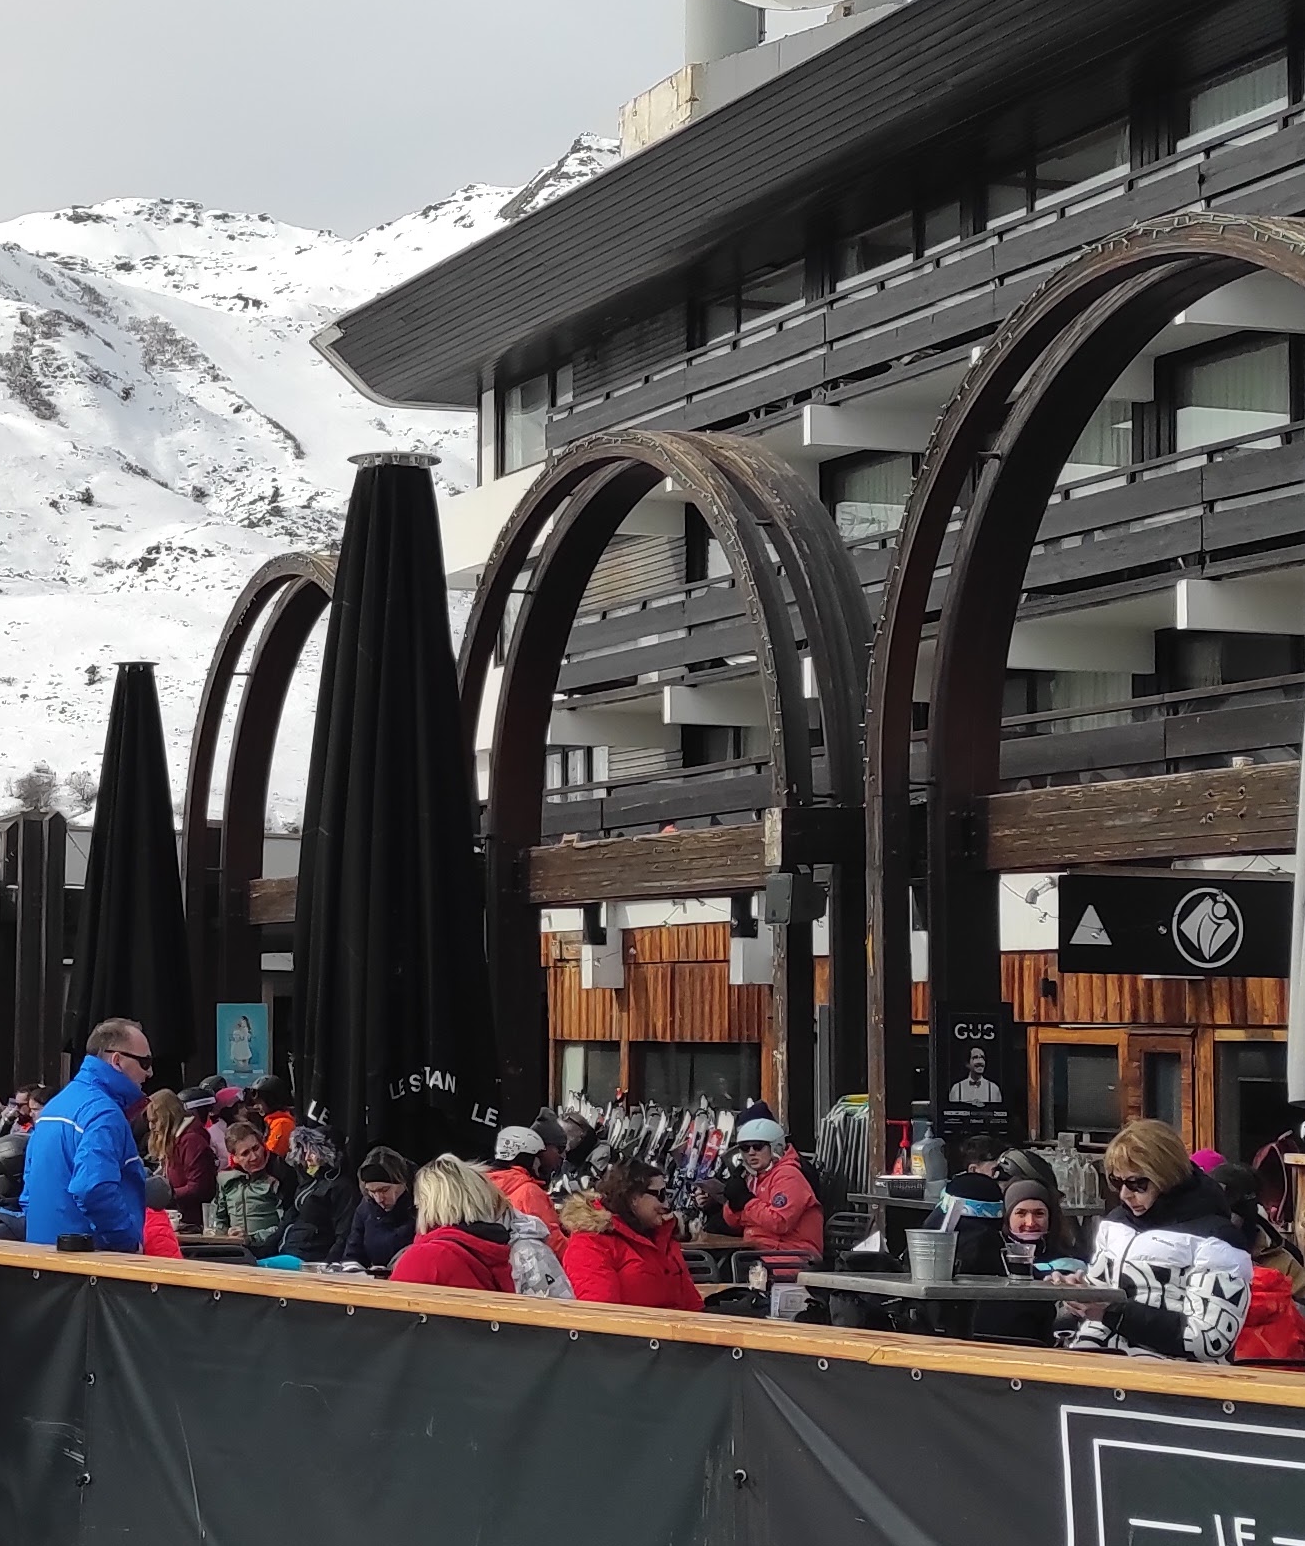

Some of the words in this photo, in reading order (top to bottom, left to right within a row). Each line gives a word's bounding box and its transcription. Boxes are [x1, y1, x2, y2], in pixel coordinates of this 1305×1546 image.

[954, 1023, 995, 1040] GUS
[307, 1099, 330, 1126] LE
[471, 1103, 499, 1127] LE
